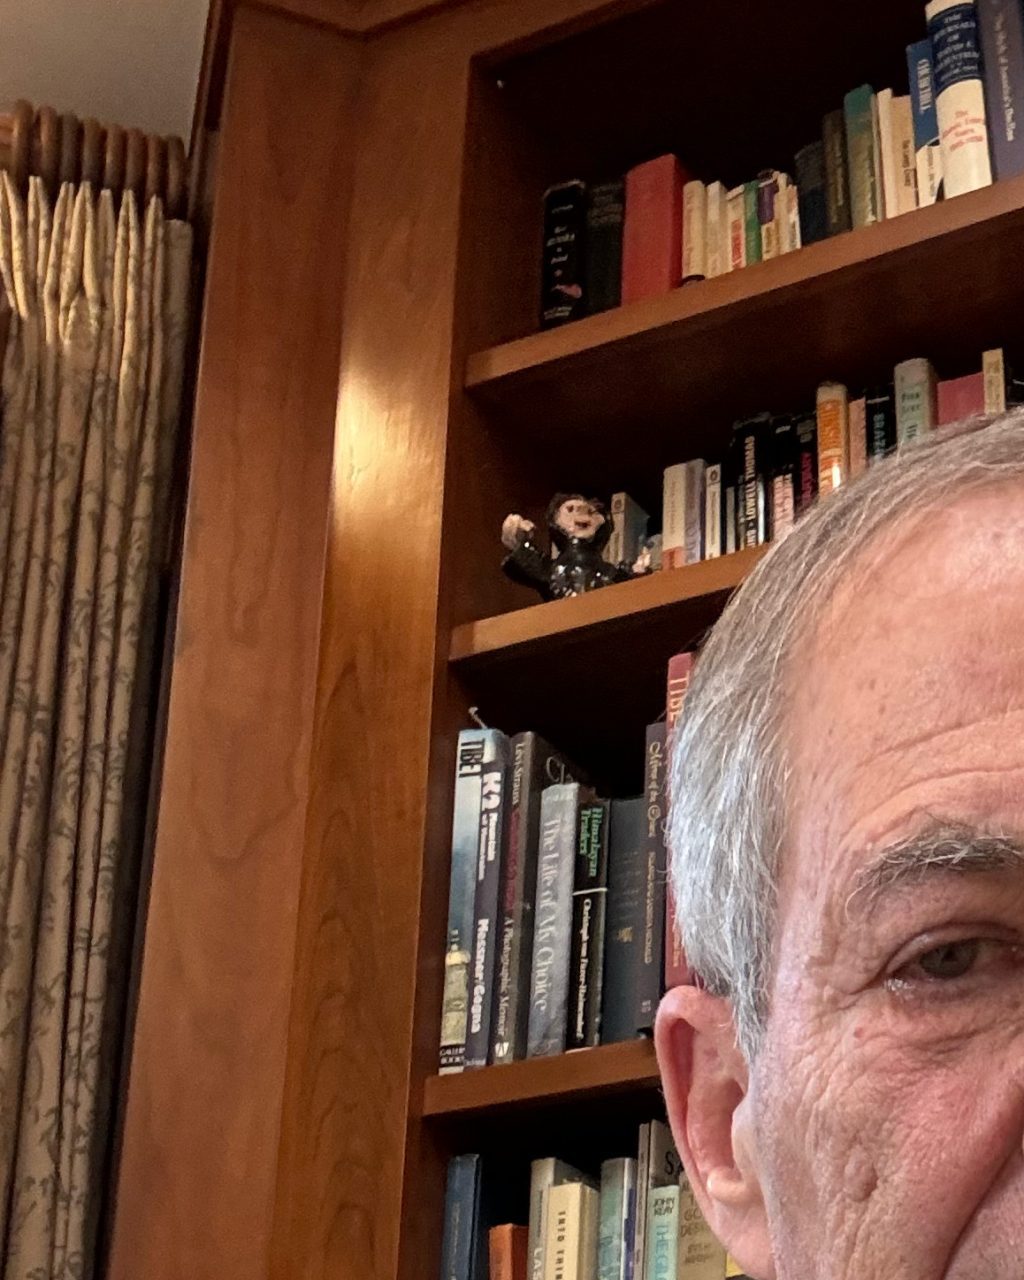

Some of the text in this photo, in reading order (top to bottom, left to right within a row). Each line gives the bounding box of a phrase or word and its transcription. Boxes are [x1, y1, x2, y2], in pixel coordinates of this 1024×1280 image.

[741, 435, 758, 520] LOWELL THOMAS
[459, 737, 486, 780] TIBET
[481, 771, 502, 812] K2
[577, 809, 592, 855] Traders
[586, 807, 603, 877] Himalayan
[532, 813, 562, 1011] The Life of My Choice
[498, 928, 514, 994] Photographic
[497, 996, 509, 1037] Memoir
[653, 1197, 674, 1208] JOHN
[557, 1211, 566, 1242] INTO
[655, 1225, 671, 1255] THE
[555, 1250, 564, 1280] THIN
